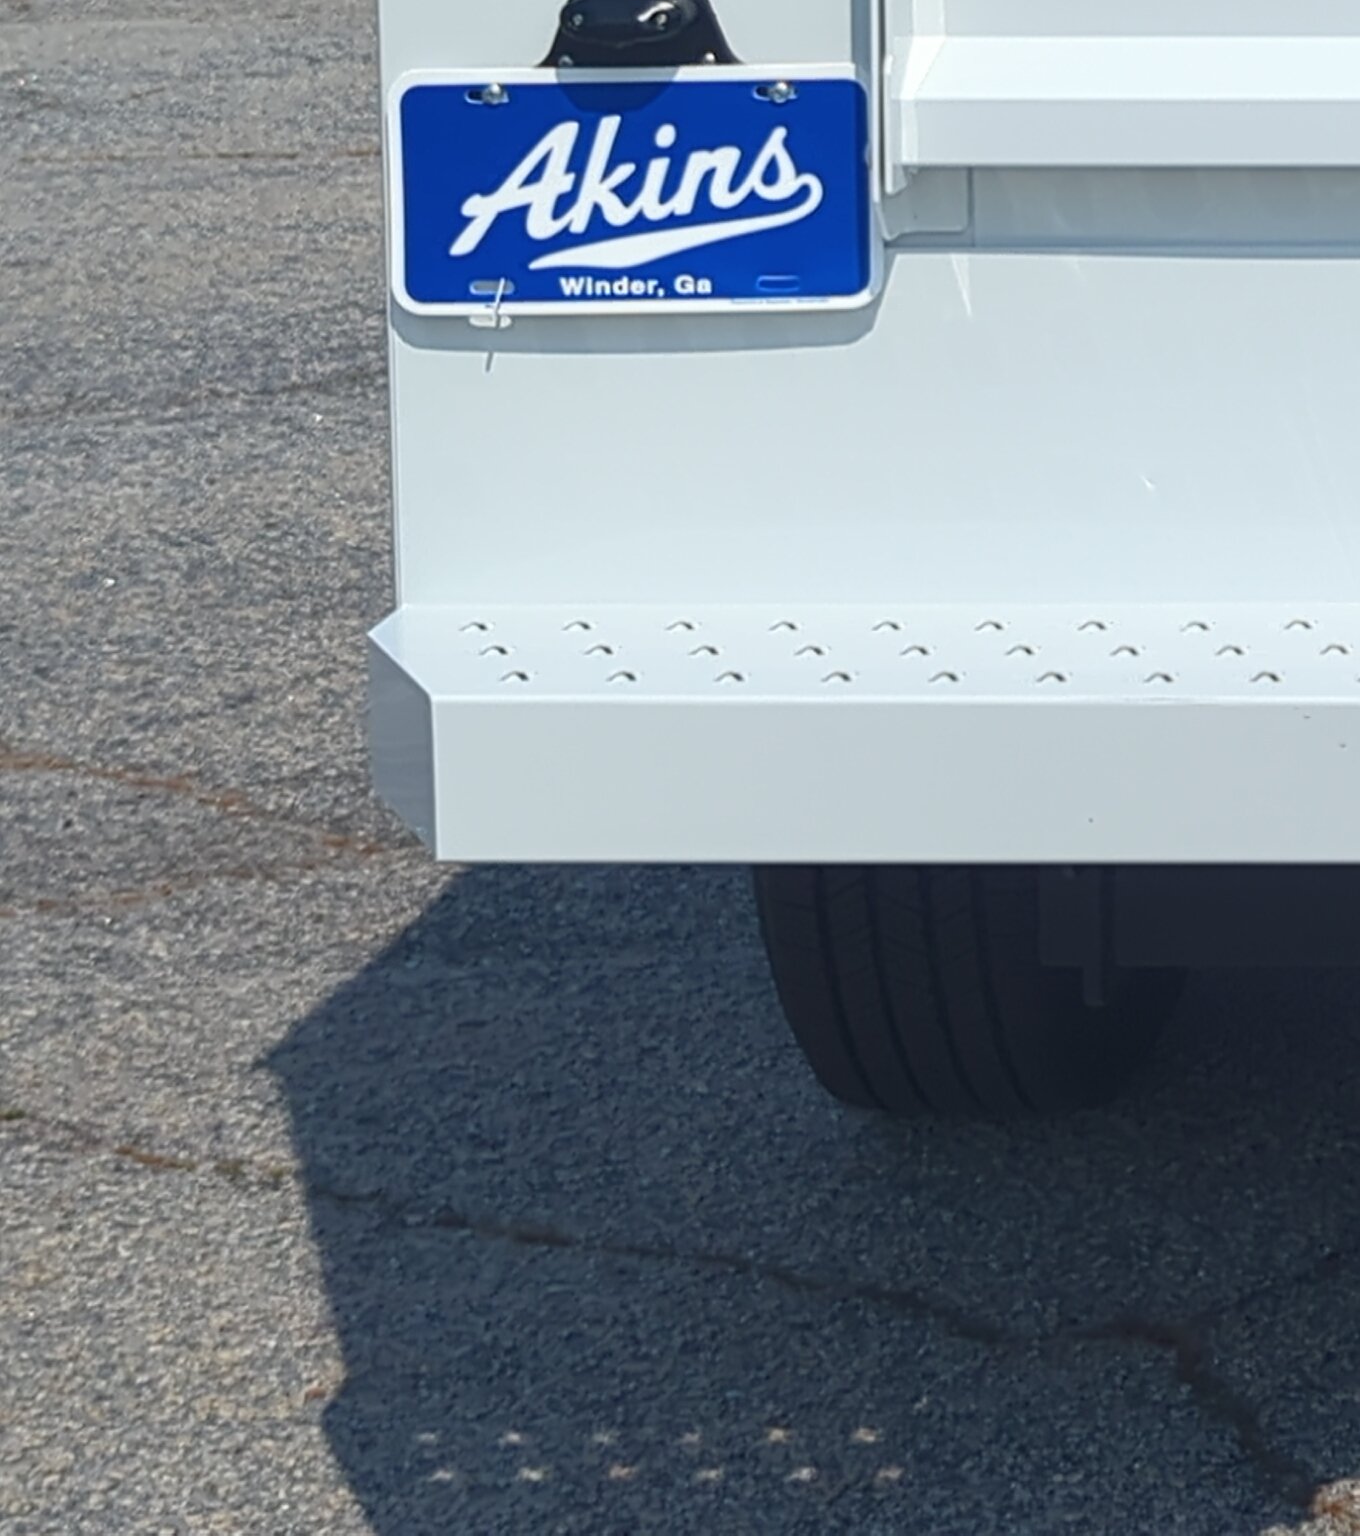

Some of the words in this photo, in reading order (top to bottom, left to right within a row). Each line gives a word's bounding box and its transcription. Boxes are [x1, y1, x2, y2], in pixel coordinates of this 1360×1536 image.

[449, 115, 823, 256] Akins
[559, 275, 665, 298] Winder,
[674, 275, 713, 295] Ga
